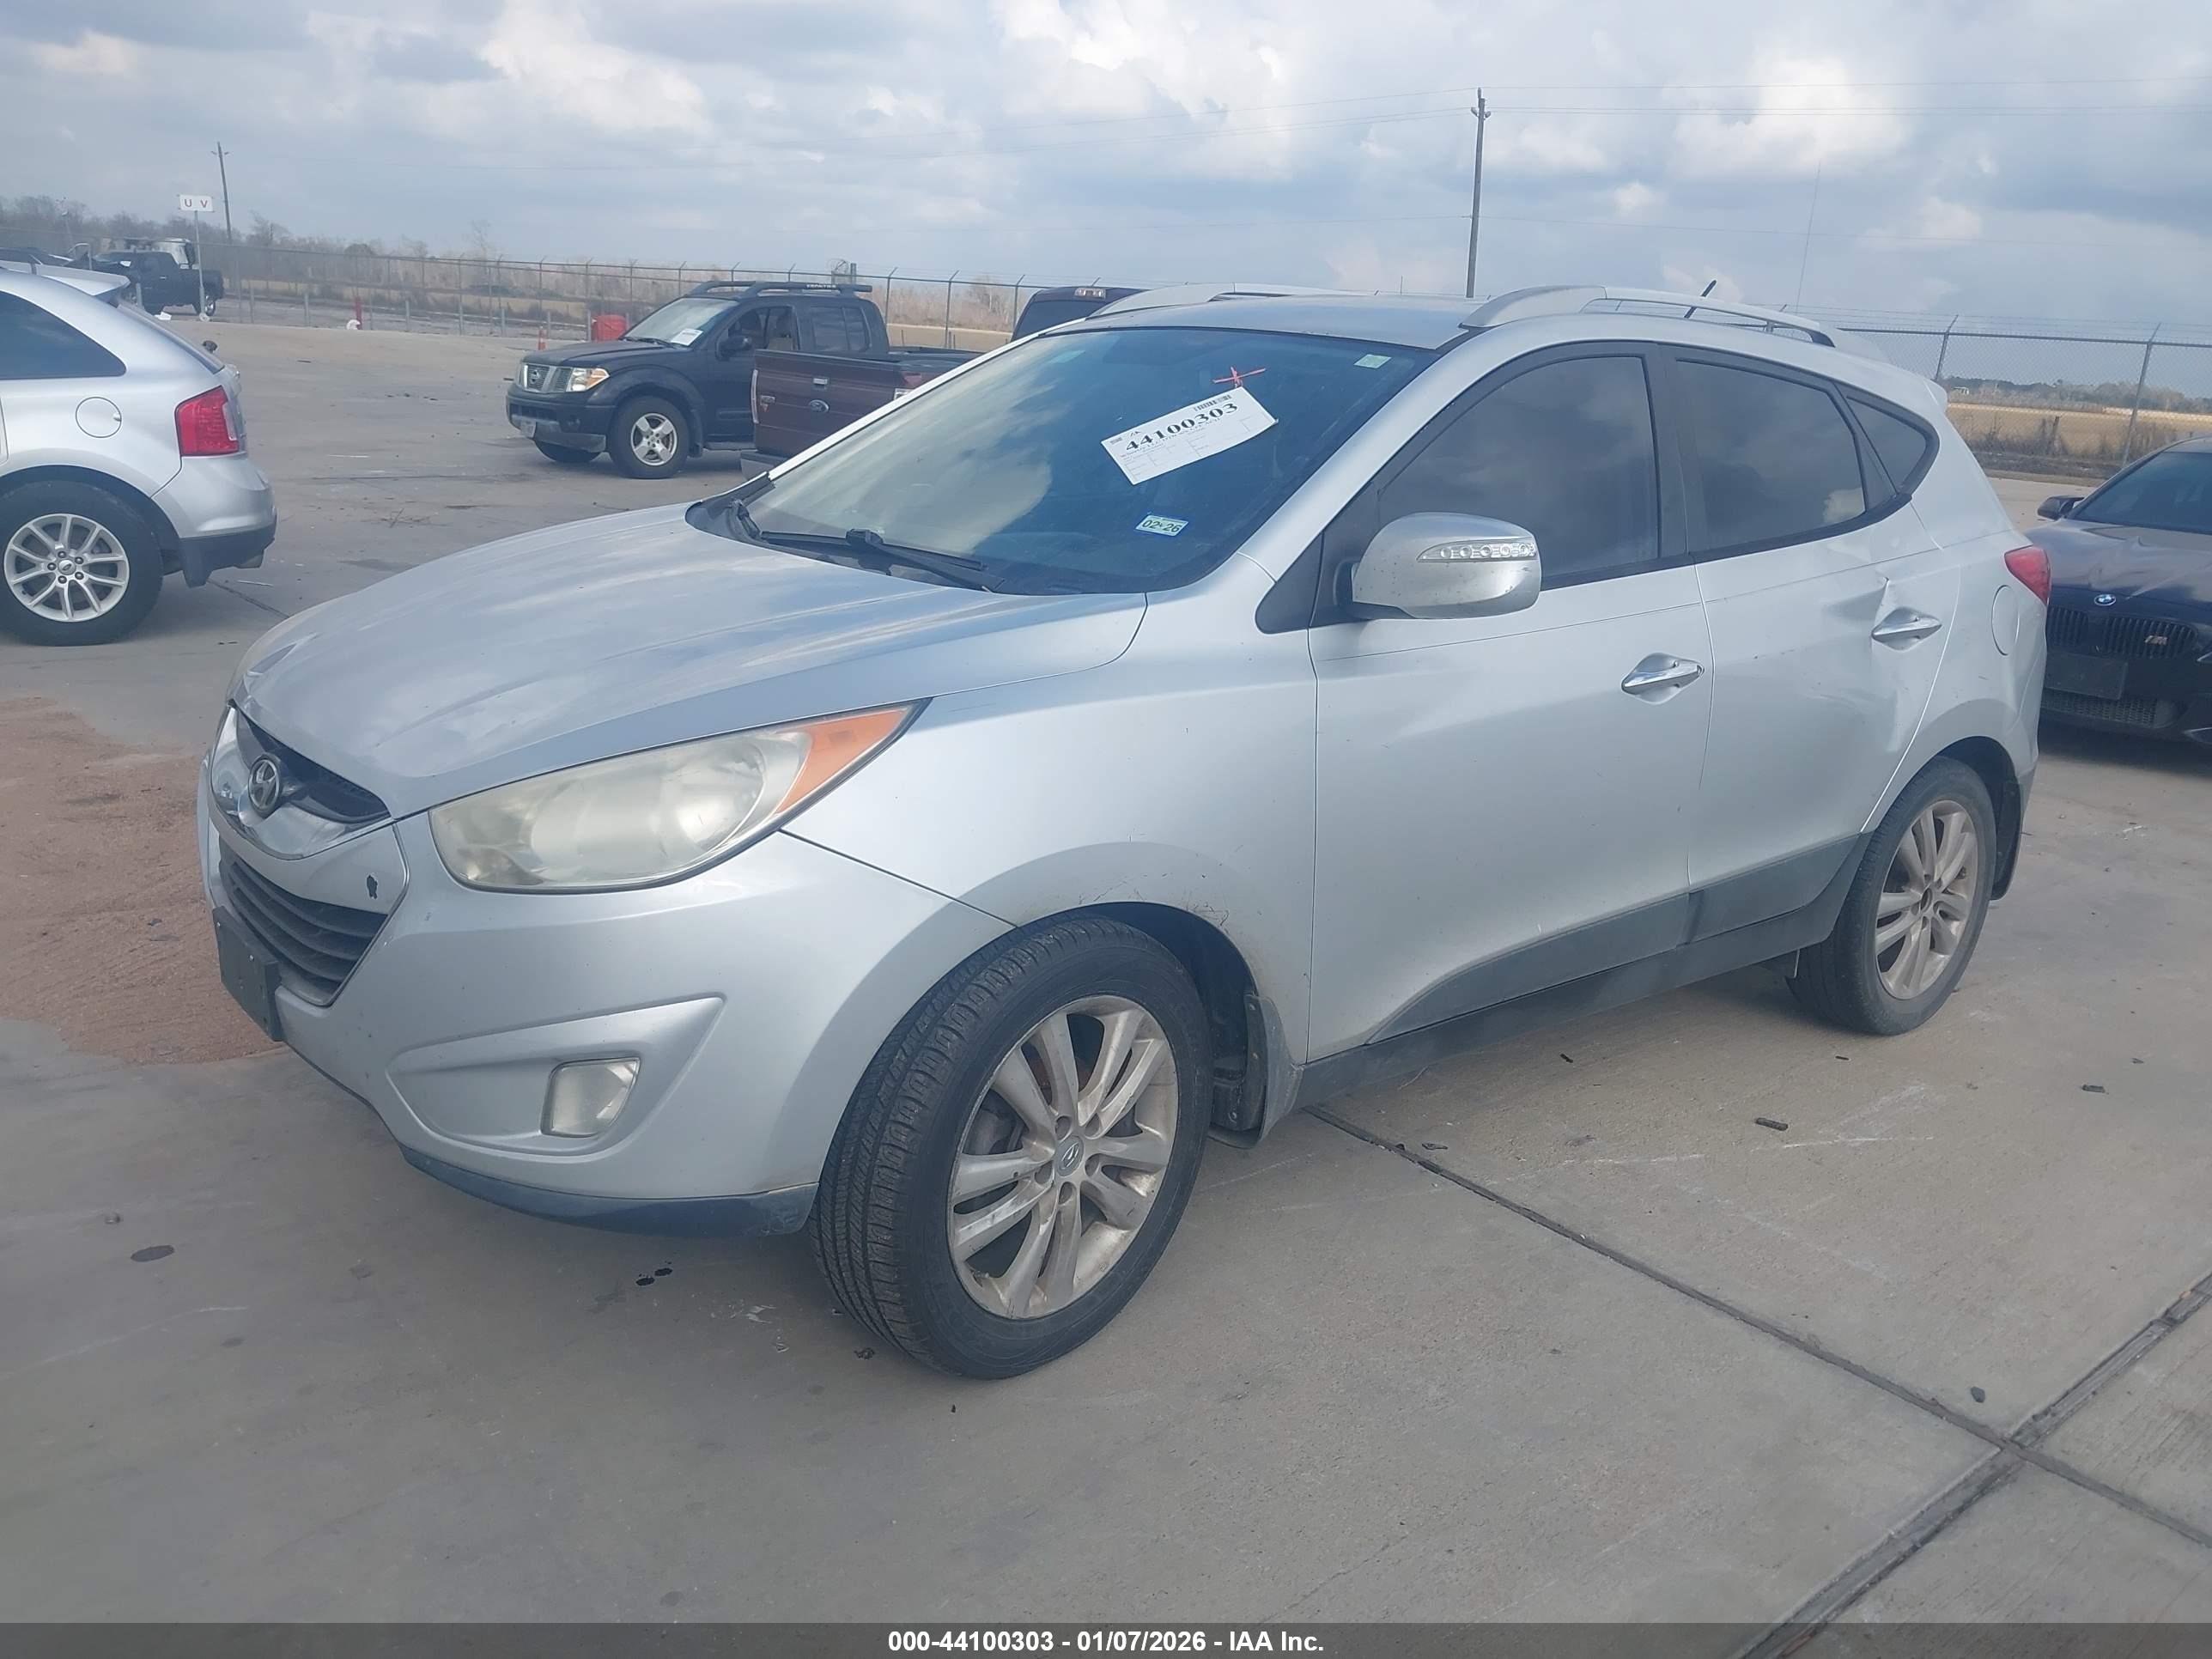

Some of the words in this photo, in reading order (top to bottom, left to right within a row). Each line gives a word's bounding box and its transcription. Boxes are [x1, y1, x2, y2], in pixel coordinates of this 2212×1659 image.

[185, 199, 192, 208] U
[200, 198, 208, 209] V
[1126, 403, 1238, 452] 44100303
